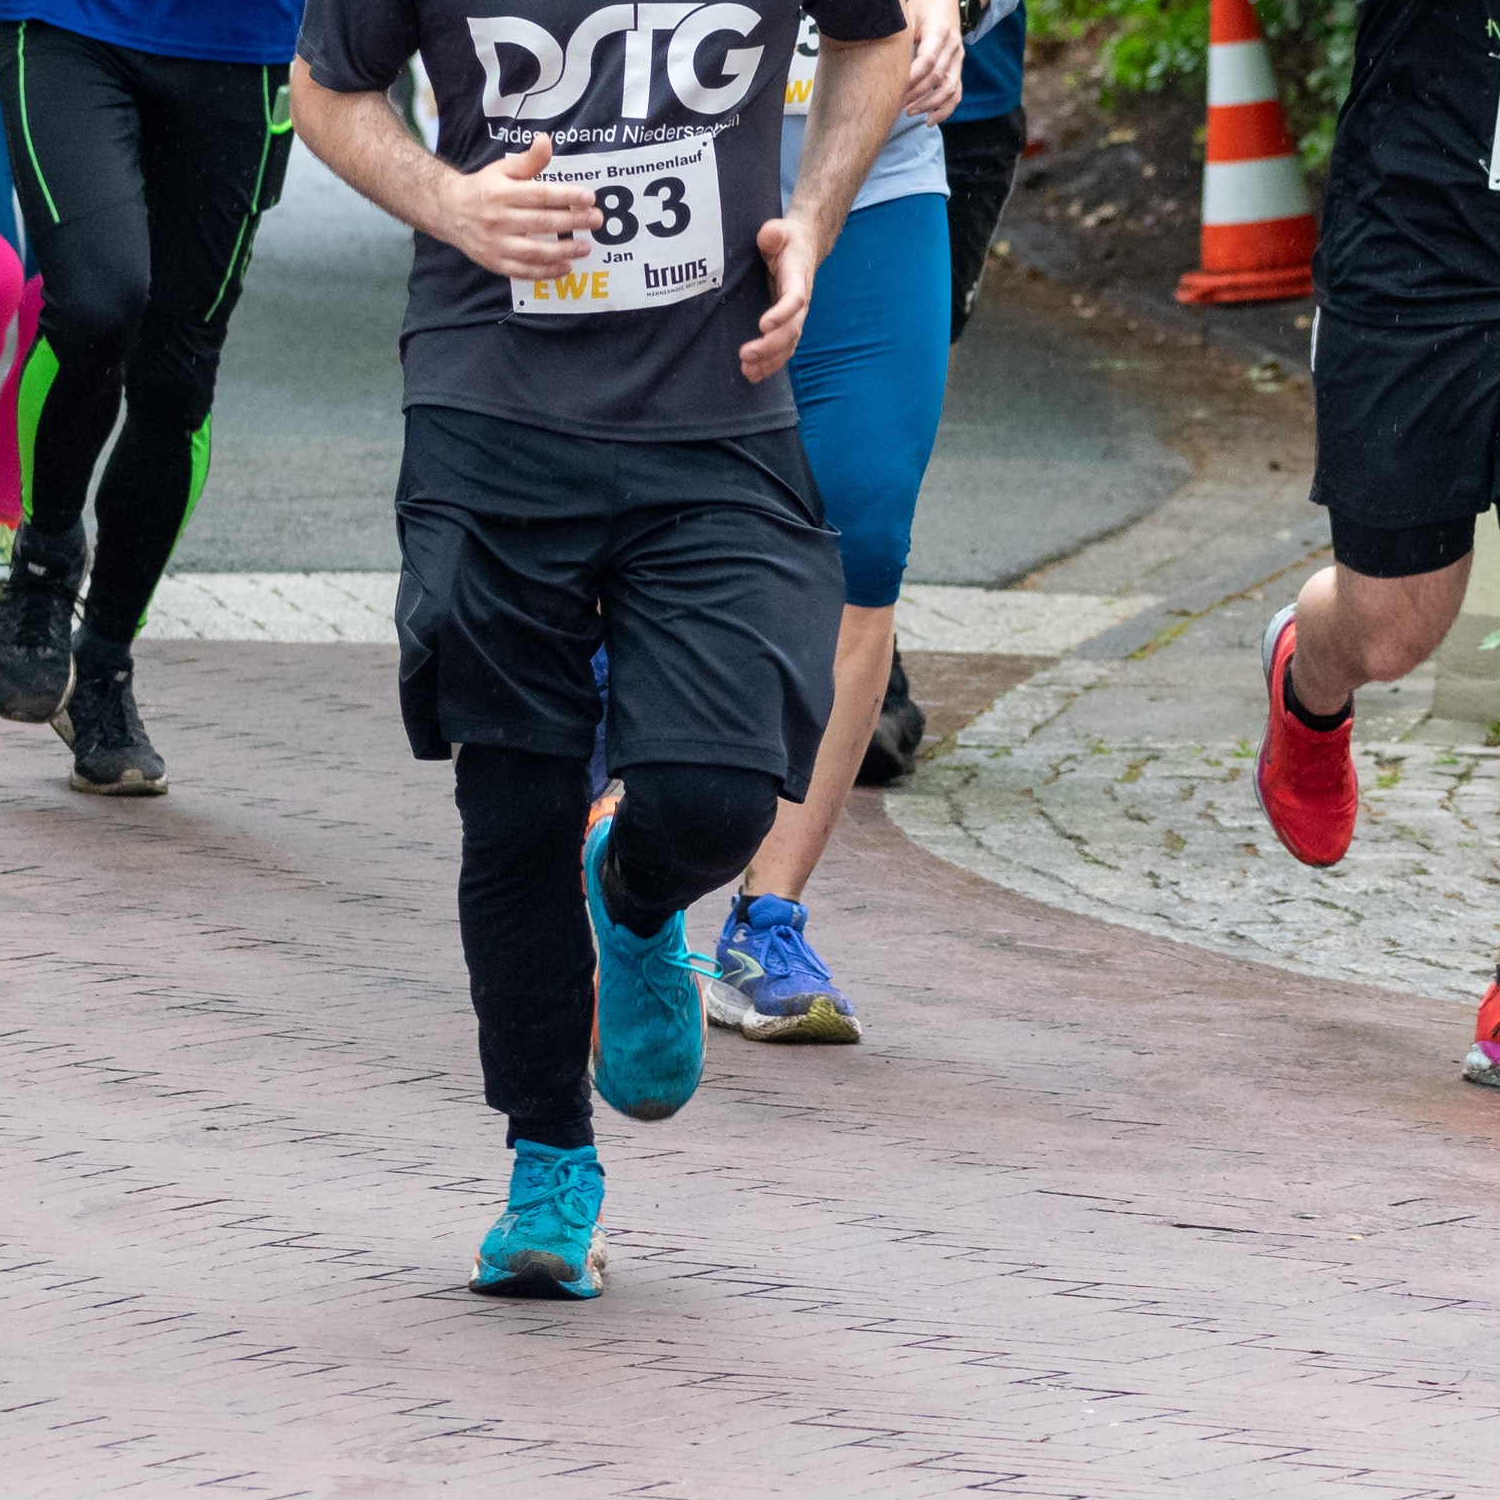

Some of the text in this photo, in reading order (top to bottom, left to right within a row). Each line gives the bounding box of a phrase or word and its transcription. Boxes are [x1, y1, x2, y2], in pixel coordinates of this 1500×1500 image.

[467, 2, 766, 120] DSTG
[528, 150, 702, 182] erstener Brunnenlauf
[557, 176, 691, 245] 83
[602, 251, 634, 264] Jan
[533, 258, 707, 300] EWE bruns
